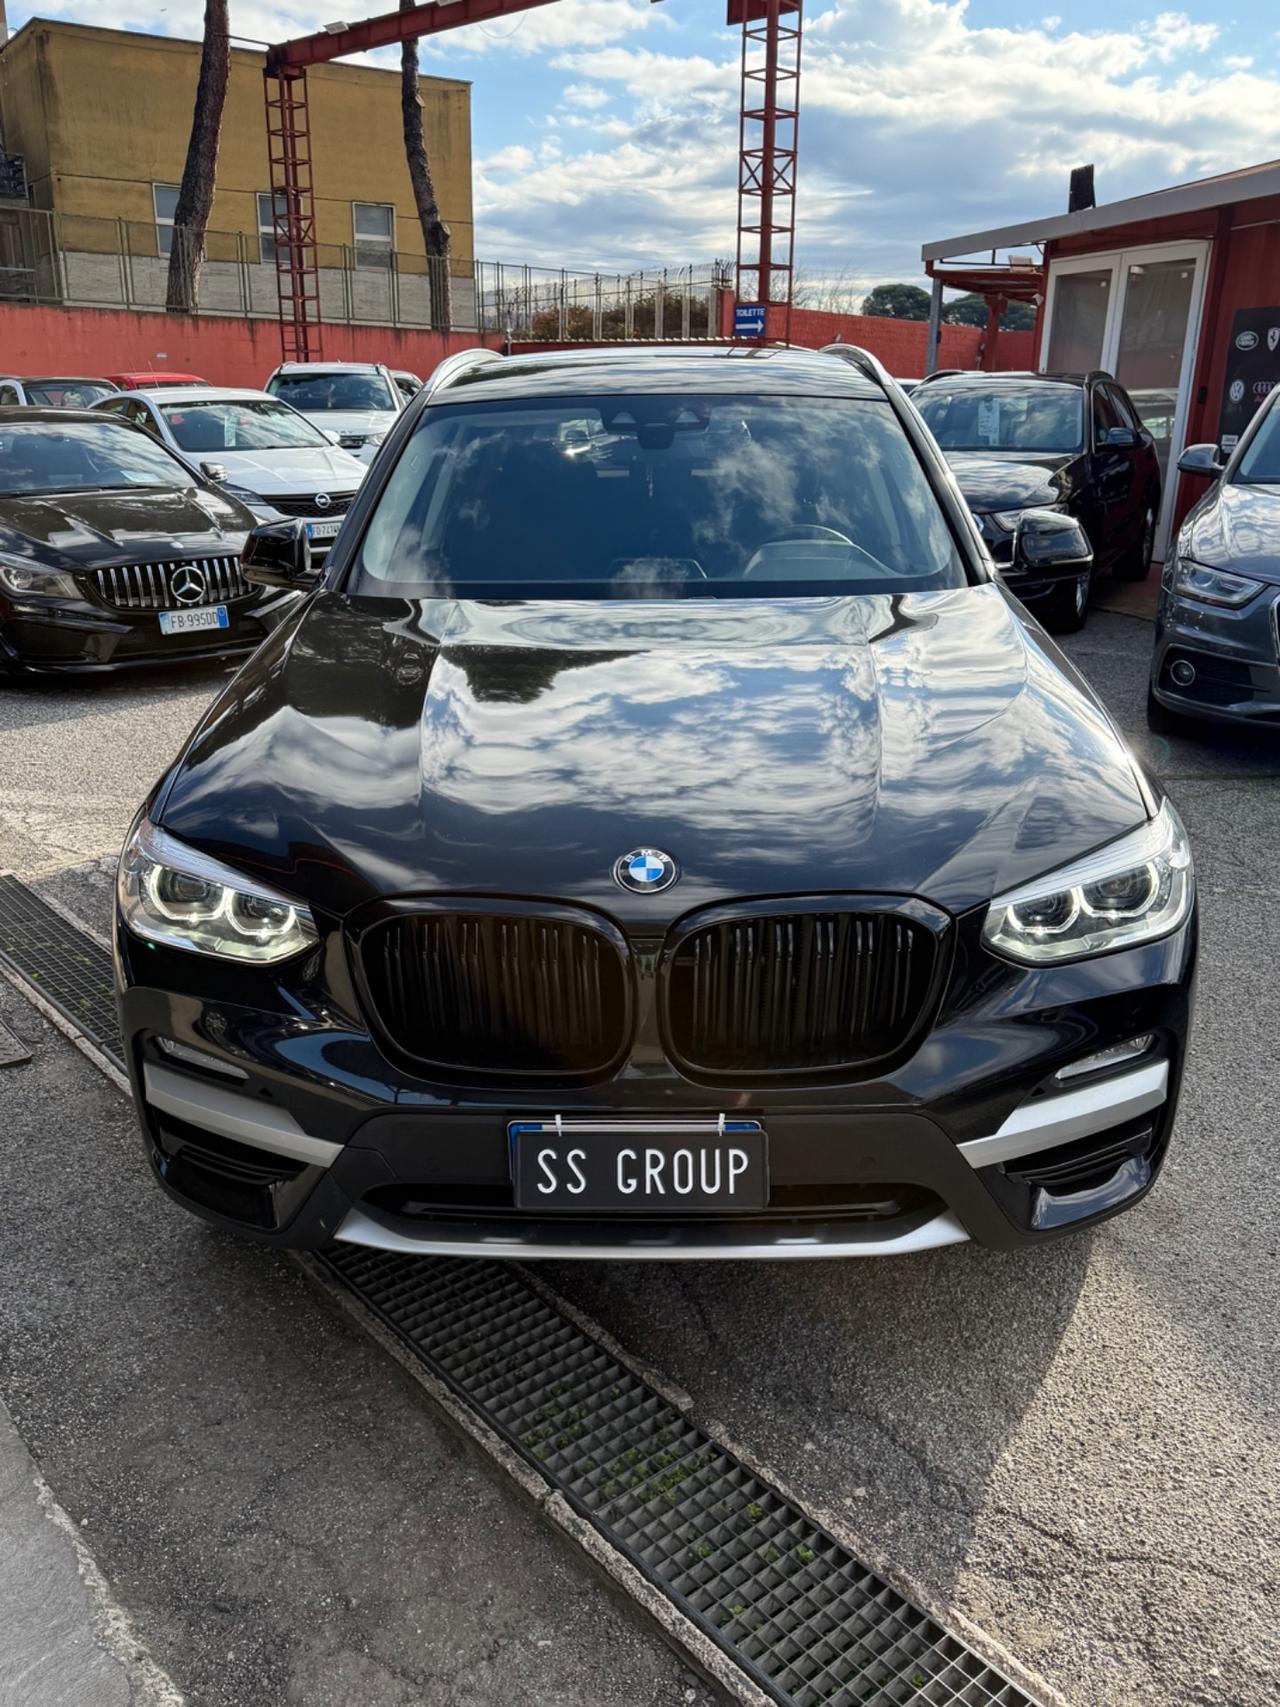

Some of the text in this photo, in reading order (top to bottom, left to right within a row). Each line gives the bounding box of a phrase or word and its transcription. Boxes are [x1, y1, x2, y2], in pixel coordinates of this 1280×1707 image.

[736, 308, 765, 317] TOILETTE
[624, 850, 672, 863] BMW
[537, 1148, 749, 1194] SS GROUP
